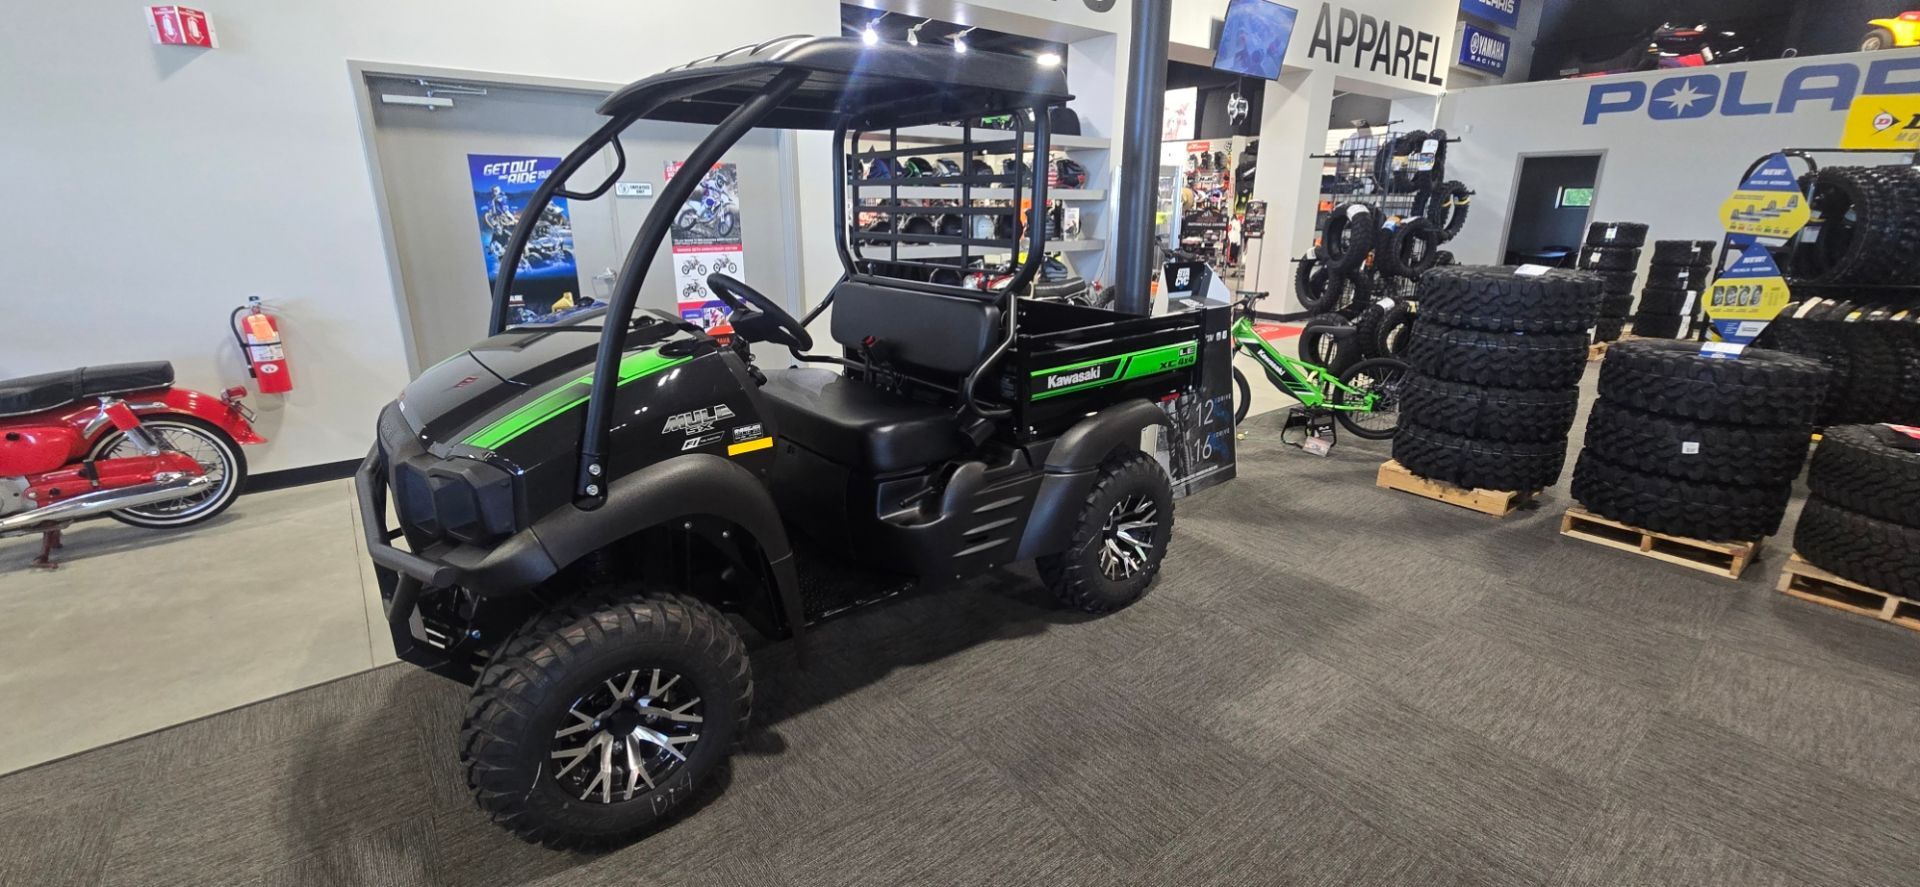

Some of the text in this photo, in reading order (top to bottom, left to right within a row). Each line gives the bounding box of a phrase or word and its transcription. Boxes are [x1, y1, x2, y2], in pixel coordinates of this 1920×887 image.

[1307, 1, 1443, 86] APPAREL
[1479, 35, 1505, 61] YAMAHA
[1471, 55, 1501, 68] RACING
[483, 163, 510, 176] GET
[510, 160, 538, 174] OUT
[507, 171, 538, 184] RIDE
[1257, 349, 1286, 376] Kawasaki
[1047, 365, 1101, 389] Kawasaki
[661, 403, 736, 435] MULE
[1196, 399, 1214, 428] 12
[1194, 434, 1213, 462] 16
